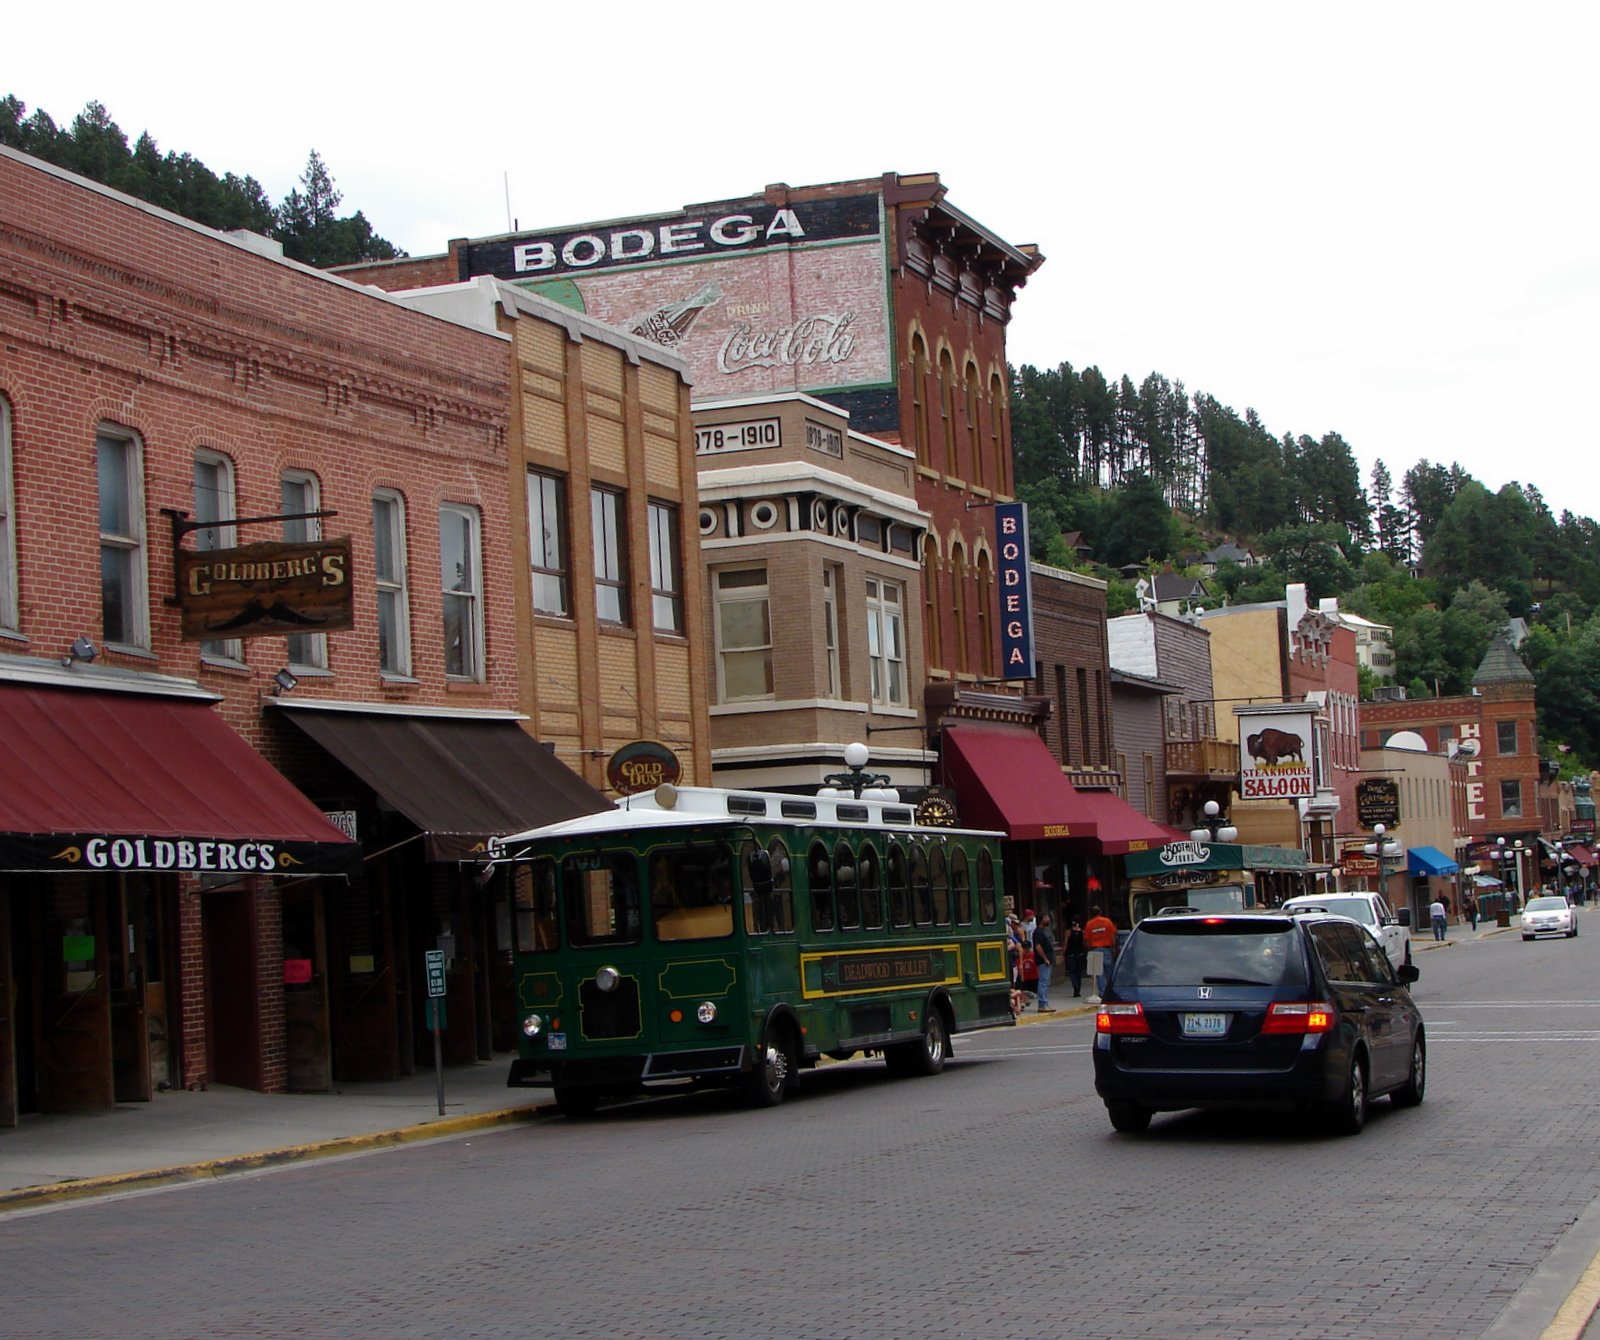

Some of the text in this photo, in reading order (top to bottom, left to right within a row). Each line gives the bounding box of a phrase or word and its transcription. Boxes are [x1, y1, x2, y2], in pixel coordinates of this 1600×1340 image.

[514, 208, 806, 273] BODEGA
[695, 424, 775, 450] 78-1910
[189, 551, 344, 595] GOLDBERG'S
[1002, 517, 1024, 664] BODEGA
[622, 761, 662, 776] GOLD
[630, 767, 665, 786] DUST
[1242, 766, 1312, 777] STEAKHOUSE
[1460, 723, 1485, 819] HOTEL
[1244, 777, 1311, 797] SALOON
[86, 838, 276, 870] GOLDBERG'S
[844, 960, 929, 980] DEADWOOD TROLLEY
